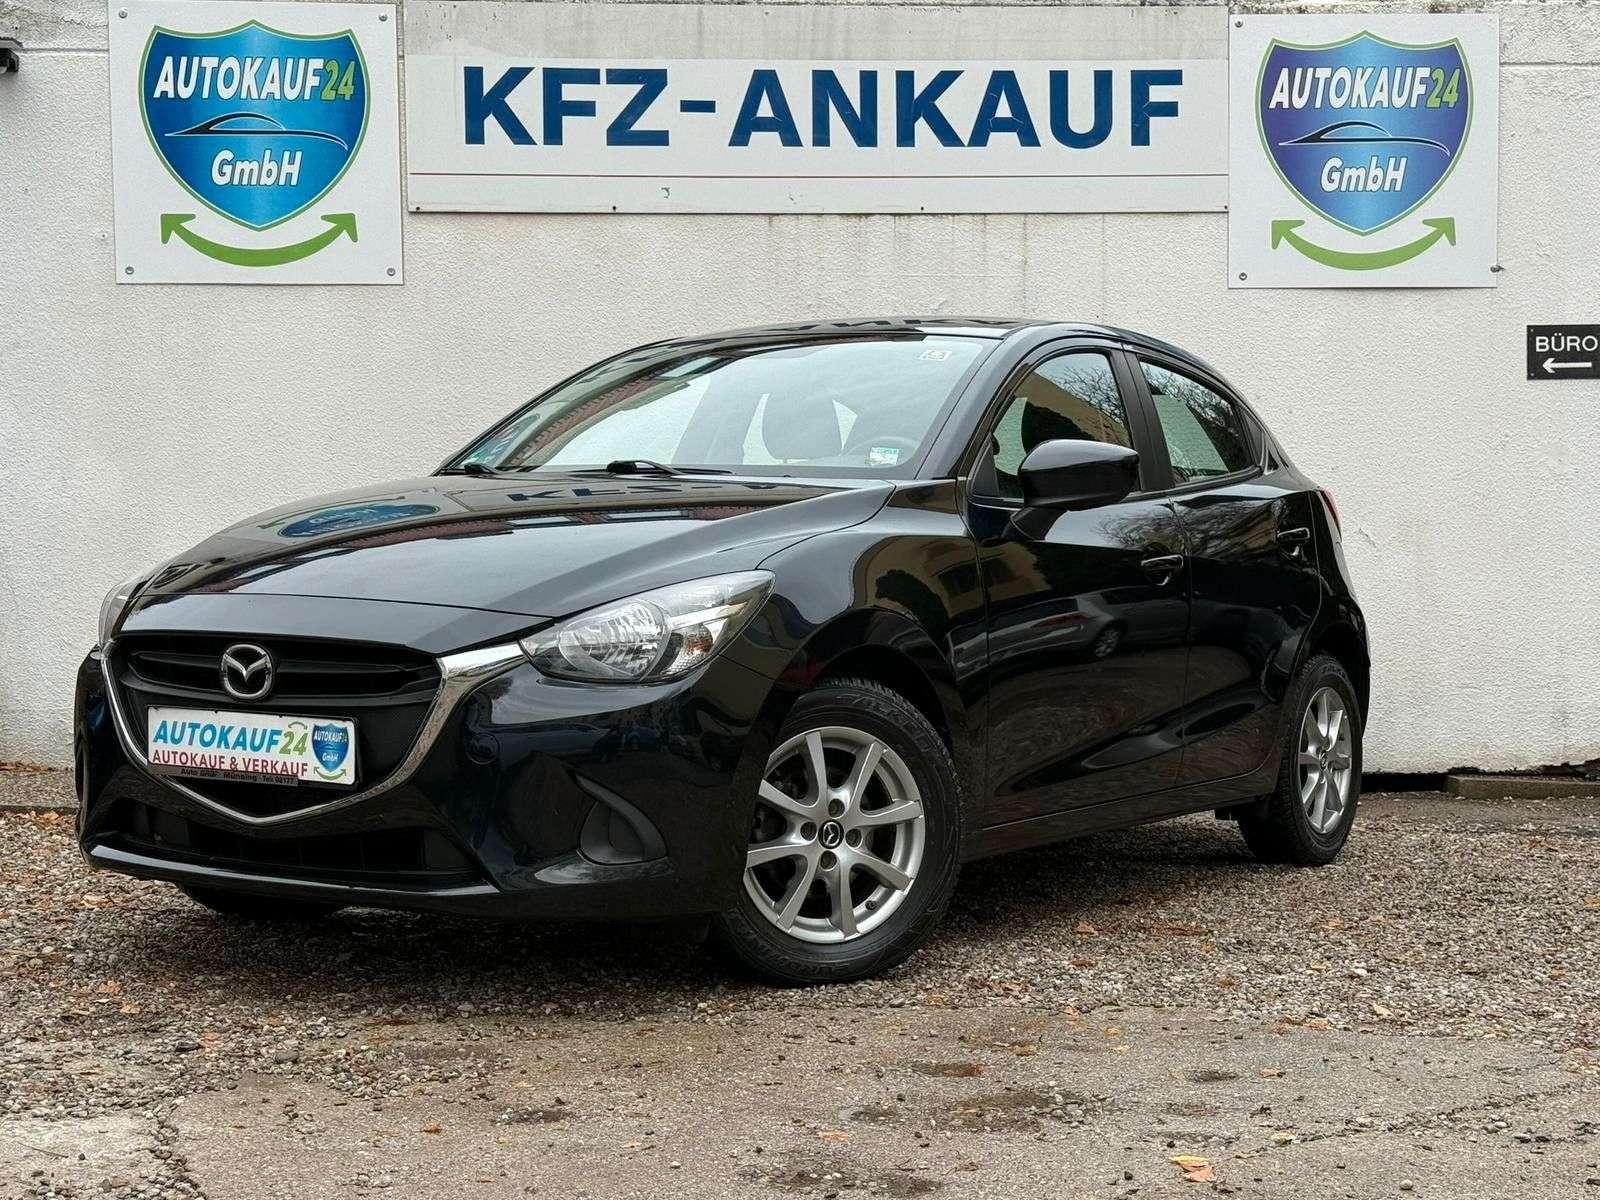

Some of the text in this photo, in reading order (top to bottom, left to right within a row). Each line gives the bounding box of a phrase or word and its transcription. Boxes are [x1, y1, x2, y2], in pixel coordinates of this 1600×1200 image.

[153, 56, 356, 101] AUTOKAUF24
[1268, 66, 1460, 110] AUTOKAUF24
[463, 66, 1184, 149] KFZ-ANKAUF
[211, 149, 302, 187] GmbH
[1320, 156, 1407, 193] GmbH
[1535, 332, 1599, 352] BÜRO
[152, 720, 309, 756] AUTOKAUF24
[153, 750, 308, 777] AUTOKAUF & VERKAUF
